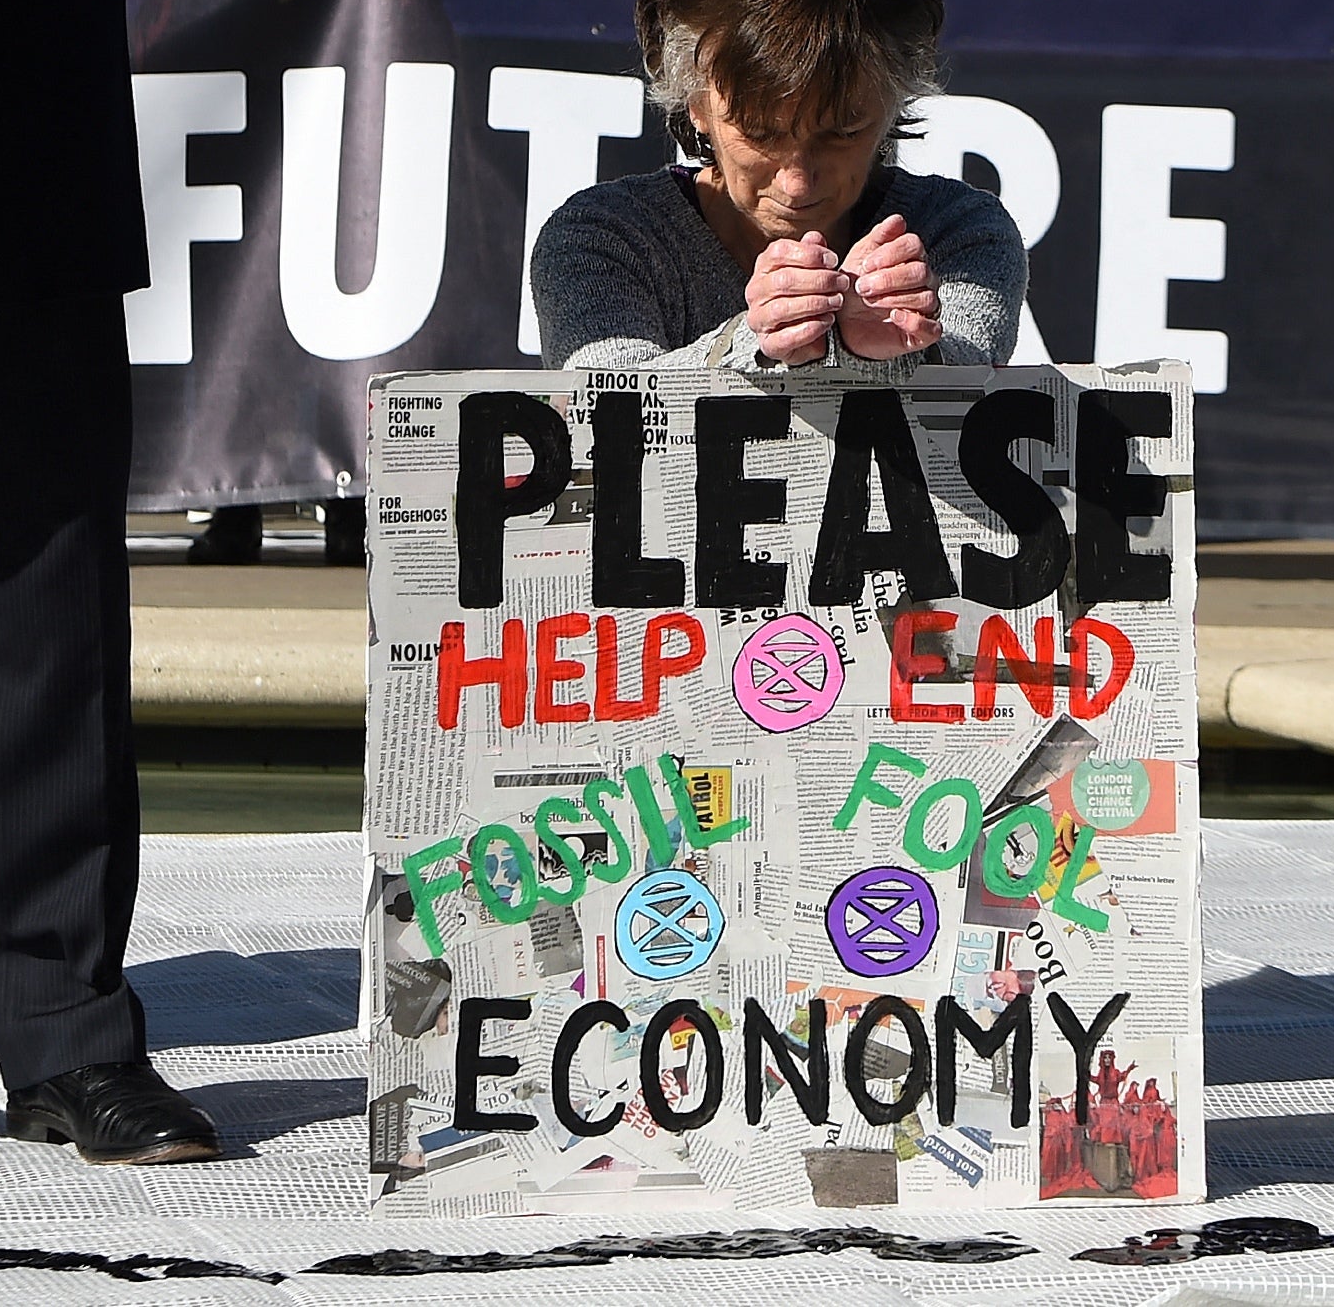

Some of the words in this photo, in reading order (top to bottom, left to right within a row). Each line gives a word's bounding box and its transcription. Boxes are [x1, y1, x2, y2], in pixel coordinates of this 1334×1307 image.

[123, 63, 1234, 395] FUTRE
[586, 372, 638, 391] DOUBT
[388, 396, 443, 411] FIGHTING
[388, 411, 411, 424] FOR
[388, 424, 436, 439] CHANGE
[379, 496, 401, 510] FOR
[457, 388, 1173, 610] PLEASE
[379, 508, 448, 524] HEDGEHOGS
[437, 612, 707, 731] HELP
[890, 611, 1136, 725] END
[386, 771, 395, 799] London
[500, 774, 534, 787] ARTS
[539, 775, 549, 786] &
[1088, 774, 1133, 785] LONDON
[1086, 785, 1134, 796] CLIMATE
[1088, 796, 1132, 807] CHANGE
[1085, 807, 1136, 819] FESTIVAL
[401, 751, 752, 958] FOSSIL
[832, 743, 1110, 933] FOOL
[795, 901, 813, 911] Bad
[513, 939, 527, 979] PINE
[453, 991, 1131, 1137] ECONOMY
[374, 1103, 386, 1163] EXCLUSIVE
[386, 1101, 398, 1163] INTERVIEW
